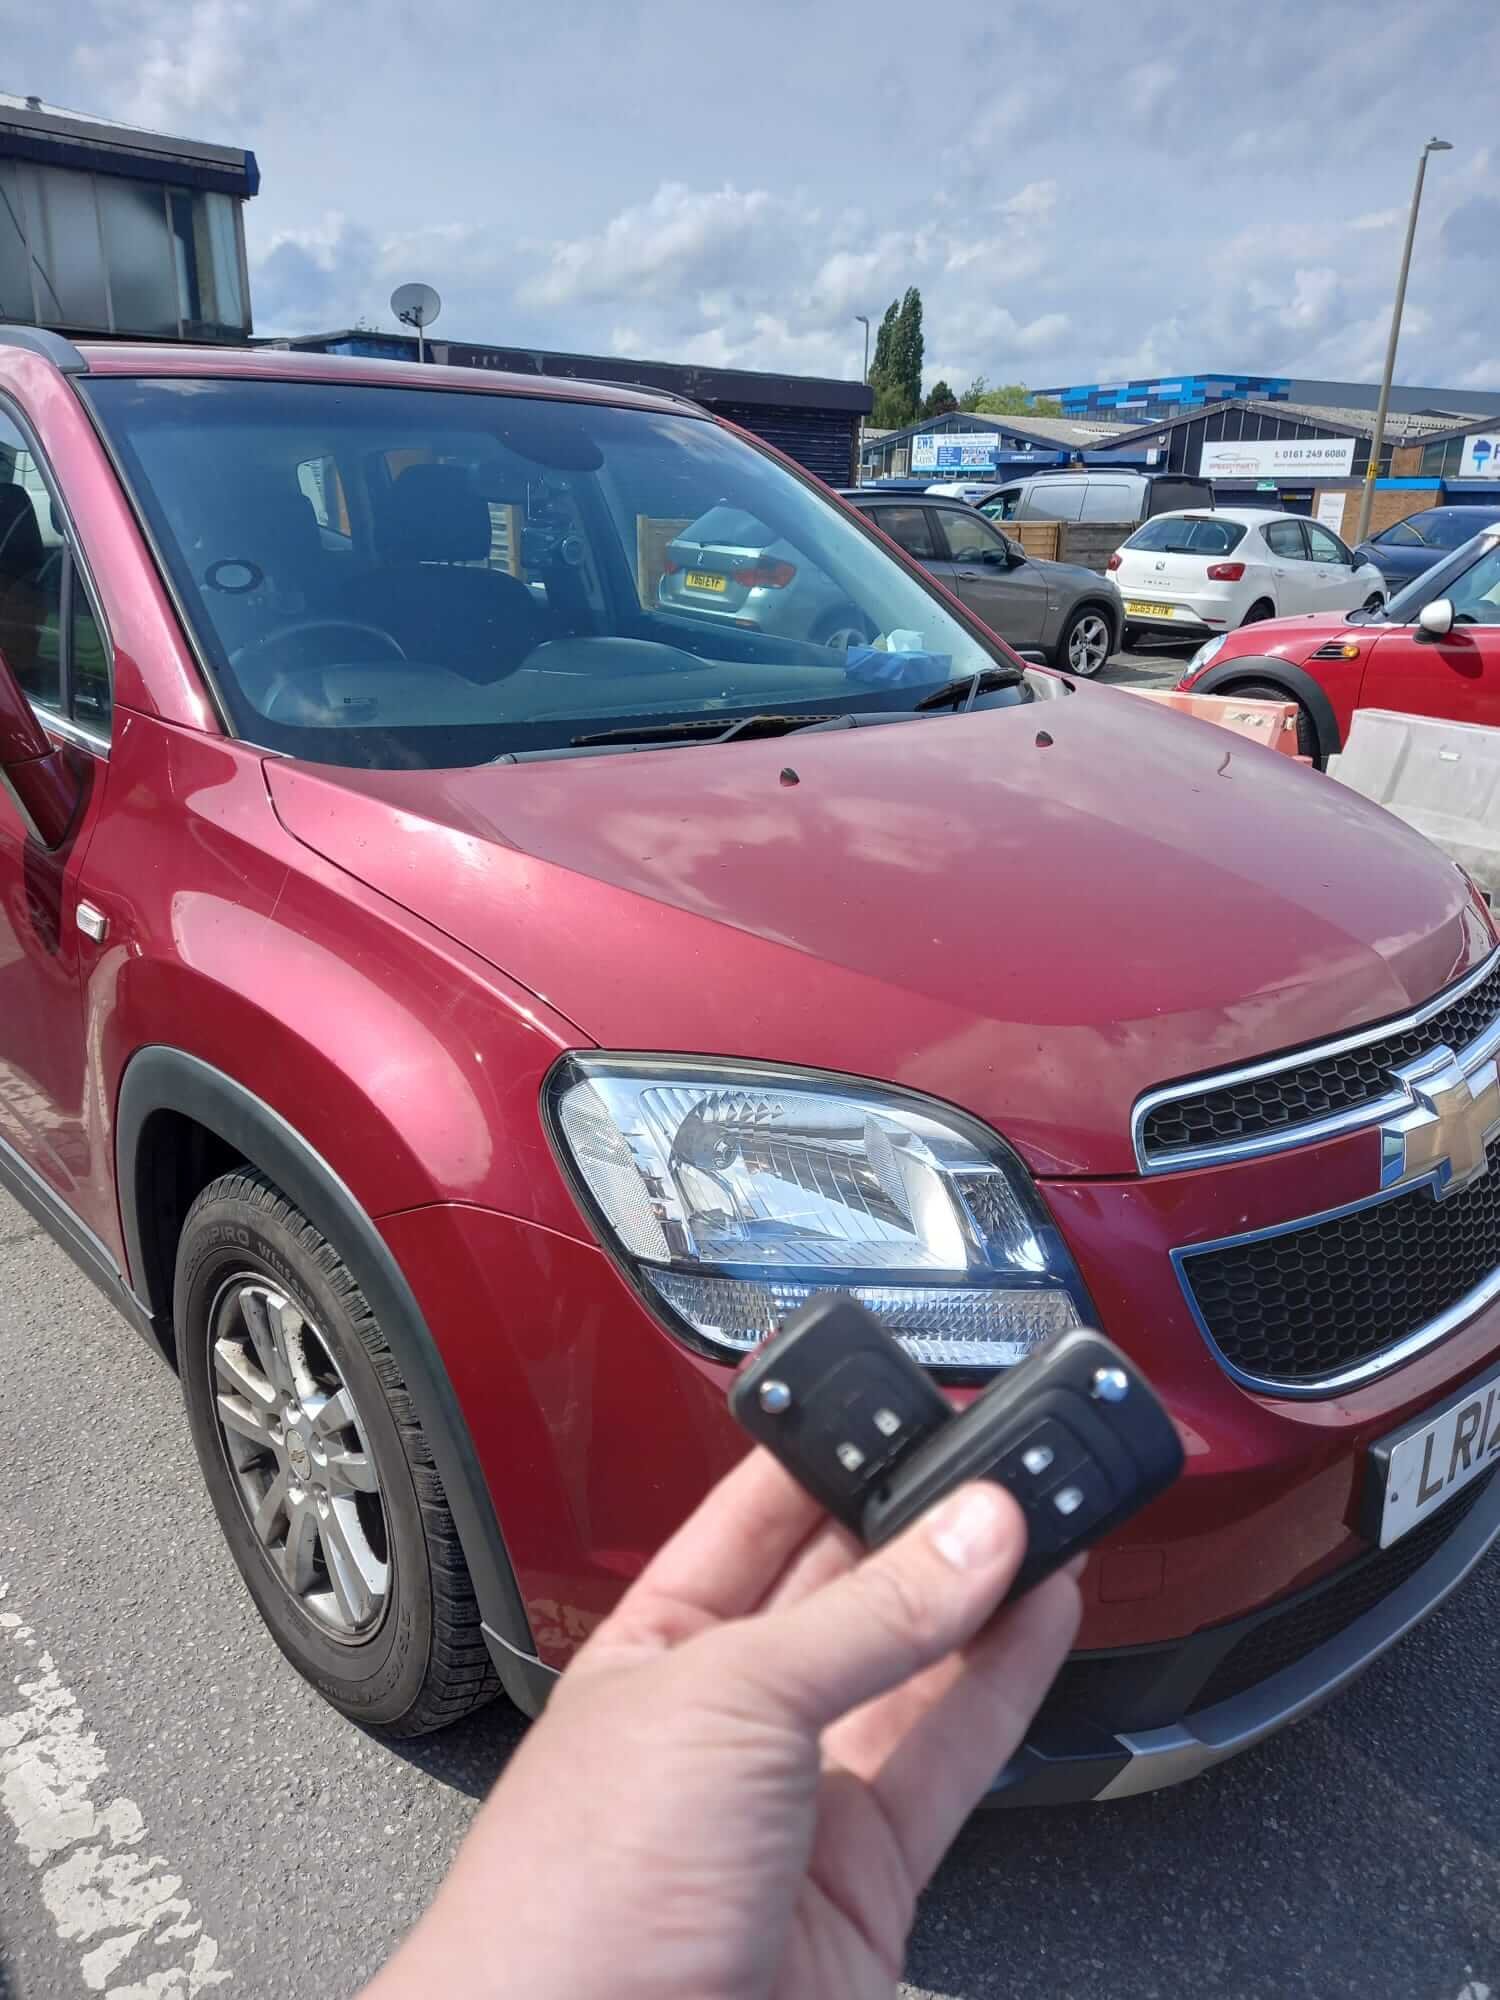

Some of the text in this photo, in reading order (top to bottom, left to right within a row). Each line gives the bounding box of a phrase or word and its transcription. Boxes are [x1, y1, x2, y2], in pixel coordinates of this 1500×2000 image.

[1283, 450, 1303, 459] 0161
[1307, 449, 1323, 459] 249
[1325, 448, 1347, 458] 6080
